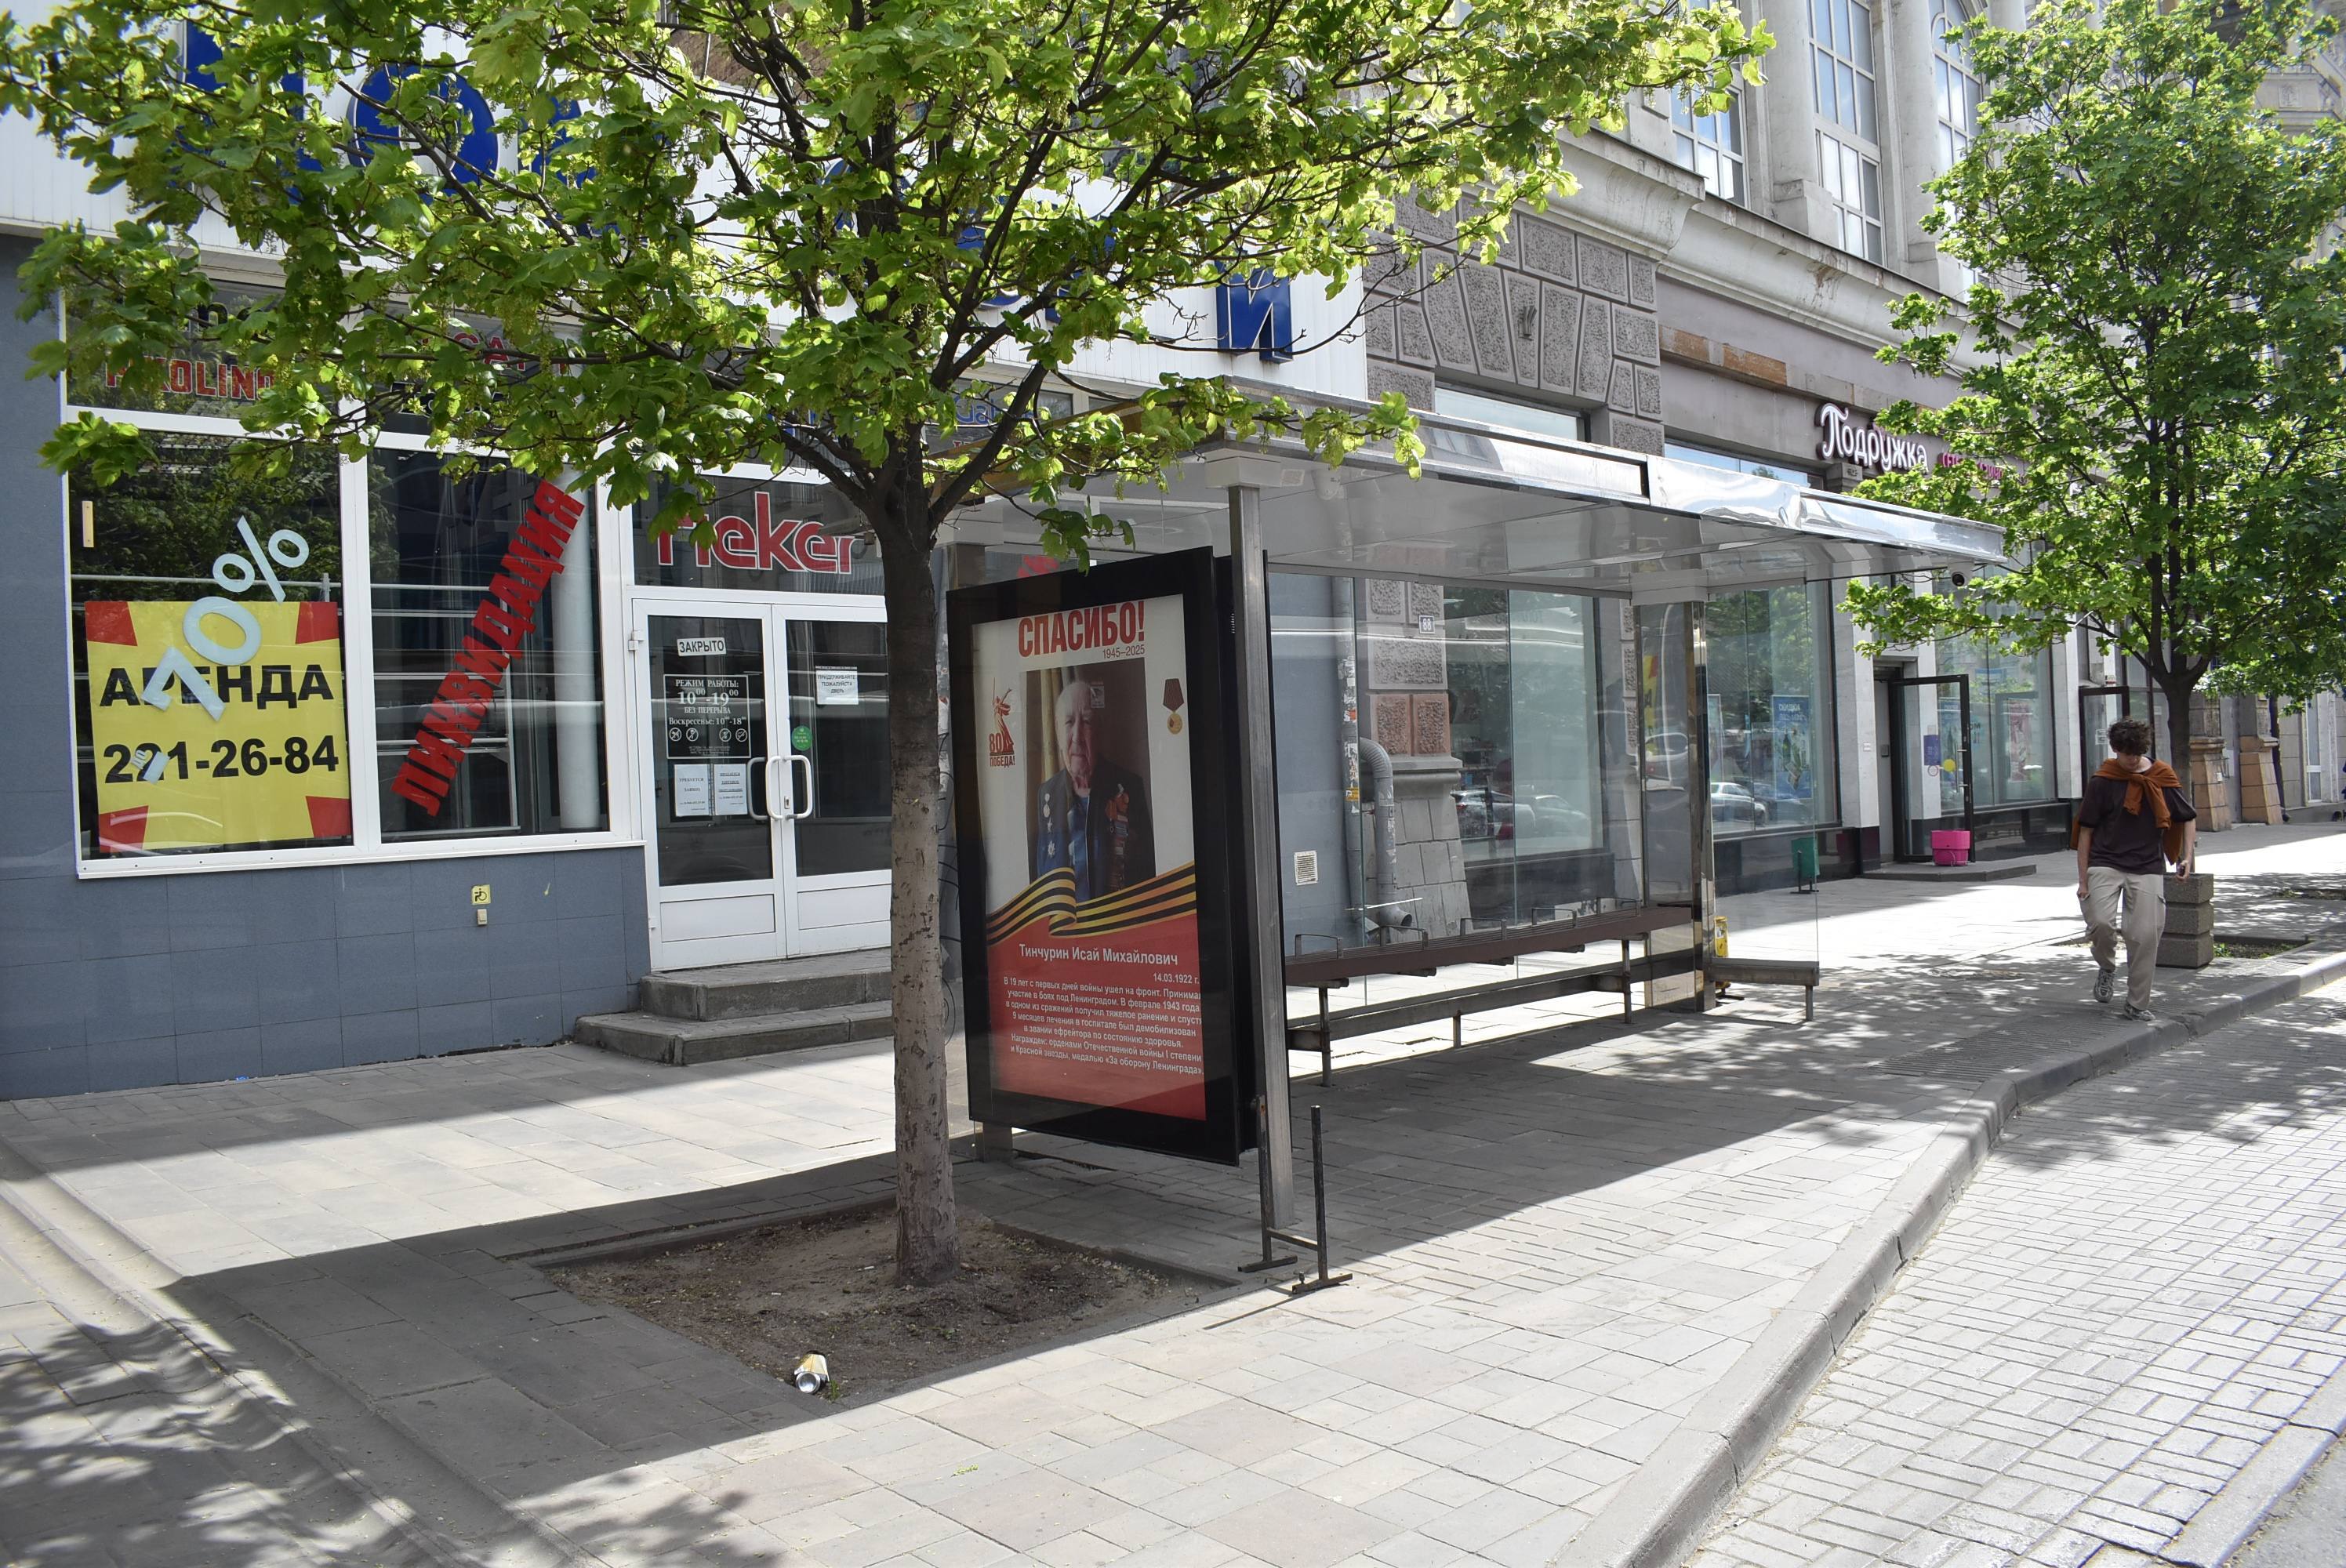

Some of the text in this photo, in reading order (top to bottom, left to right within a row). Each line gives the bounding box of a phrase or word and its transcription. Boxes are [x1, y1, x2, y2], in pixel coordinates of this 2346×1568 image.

[1816, 403, 1929, 474] Подружка
[1019, 601, 1145, 658] СПАСИБО!
[392, 479, 586, 818] ЛИКВИДАЦИЯ
[679, 640, 725, 653] ЗАКРЫТО
[675, 679, 704, 688] РЕЖИМ
[669, 717, 715, 727] Воскресенье:
[103, 735, 340, 784] 221-26-84
[989, 753, 1015, 768] ПОБЕДА!
[1019, 943, 1178, 966] Тинчурин Исай Михайлович
[1004, 976, 1009, 985] В
[1010, 977, 1017, 986] 19
[1035, 982, 1060, 993] первых
[1062, 982, 1078, 992] дней
[1080, 982, 1103, 993] войны
[1105, 987, 1124, 996] ушел
[1136, 986, 1162, 998] фронт.
[1153, 971, 1200, 985] 14.03.1922 г.
[1008, 989, 1032, 999] участие
[1039, 990, 1055, 1001] боях
[1056, 994, 1069, 1003] под
[1070, 993, 1119, 1007] Ленинградом.
[1120, 997, 1126, 1006] В
[1128, 999, 1161, 1010] феврале
[1163, 1000, 1180, 1011] 1943
[1182, 1004, 1200, 1014] года
[1011, 1002, 1030, 1011] одном
[1040, 1004, 1073, 1014] сражений
[1074, 1006, 1105, 1018] получил
[1106, 1009, 1136, 1020] тяжелое
[1137, 1011, 1169, 1023] ранение
[1012, 1011, 1017, 1020] 9
[1018, 1013, 1045, 1024] месяцев
[1046, 1015, 1074, 1025] лечения
[1081, 1019, 1117, 1031] госпитале
[1118, 1021, 1135, 1031] был
[1135, 1024, 1197, 1037] демобилизован
[1011, 1033, 1048, 1047] Награжден:
[1049, 1039, 1082, 1050] орденами
[1083, 1040, 1138, 1055] Отечественной
[1139, 1047, 1164, 1058] войны
[1170, 1051, 1202, 1063] степени
[1029, 1025, 1053, 1035] звании
[1054, 1026, 1091, 1040] ефрейтора
[1092, 1031, 1102, 1040] по
[1103, 1033, 1143, 1045] состоянию
[1144, 1037, 1184, 1049] здоровья.
[1015, 1044, 1043, 1057] Красной
[1044, 1049, 1071, 1061] звезды,
[1071, 1051, 1104, 1063] медалью
[1106, 1055, 1118, 1065] «За
[1119, 1056, 1151, 1070] оборону
[1153, 1060, 1204, 1076] Ленинграда».
